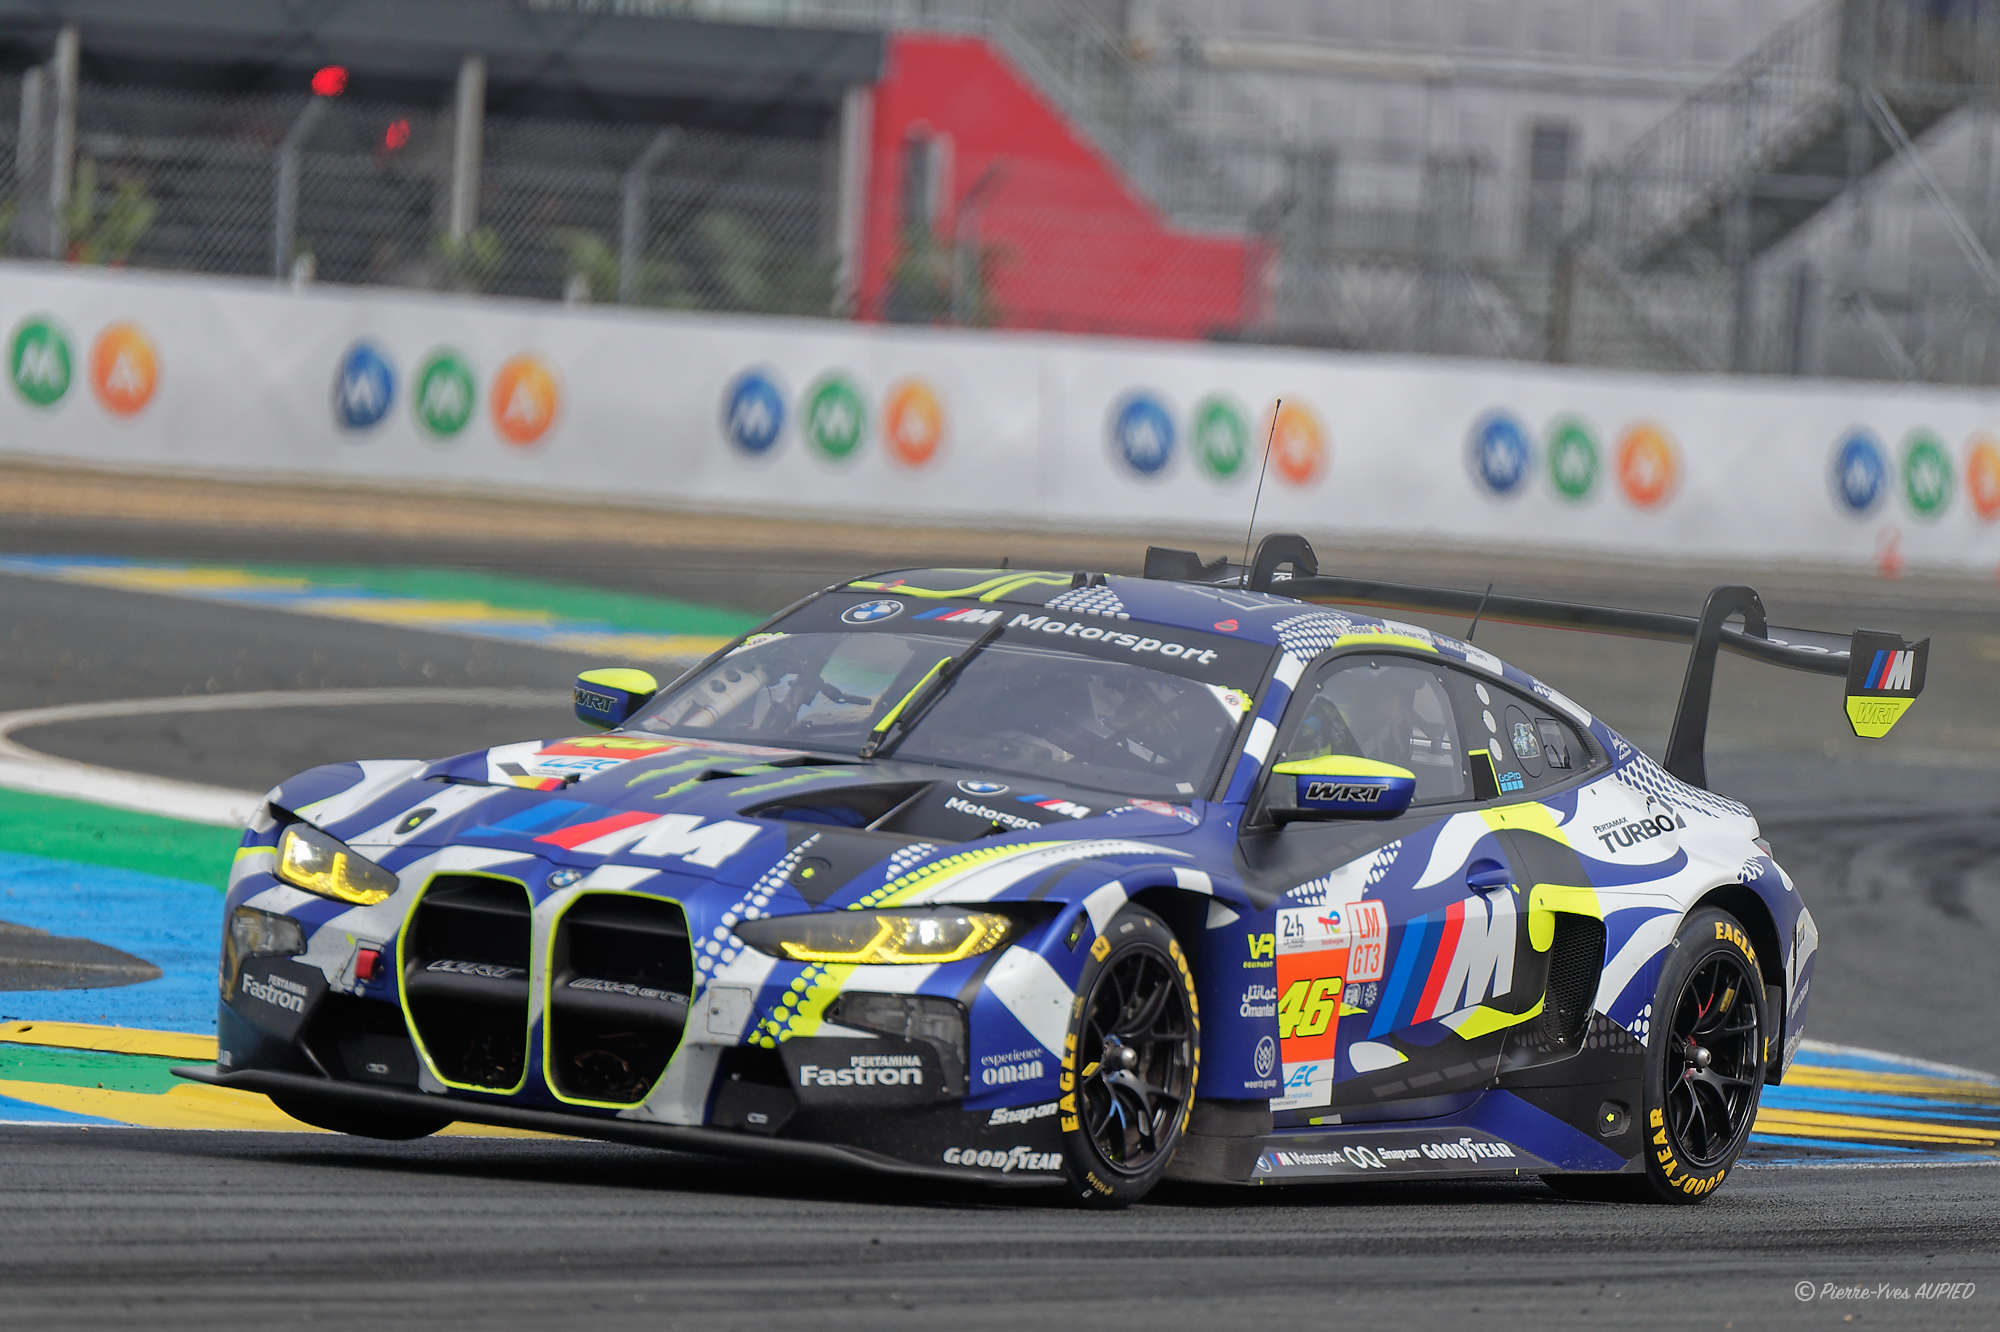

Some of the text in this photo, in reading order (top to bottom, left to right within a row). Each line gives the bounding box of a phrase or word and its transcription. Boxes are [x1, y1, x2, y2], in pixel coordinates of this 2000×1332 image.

[1007, 612, 1219, 666] Motorsport
[1855, 702, 1900, 725] WRT
[1305, 781, 1390, 803] WRT
[1498, 771, 1522, 782] GoPro
[568, 813, 763, 868] M
[1592, 816, 1629, 834] PERTAMAX
[1598, 814, 1675, 854] TURBO
[1355, 906, 1380, 939] LM
[1352, 942, 1381, 975] GT3
[1430, 886, 1518, 1019] M
[1714, 920, 1756, 966] EAGLE
[242, 972, 305, 1014] Fastron
[1277, 975, 1343, 1039] 46
[850, 1055, 922, 1067] PERTAMINA
[981, 1047, 1043, 1067] experience
[800, 1065, 922, 1087] Fastron
[982, 1060, 1044, 1086] oman
[1059, 1032, 1081, 1133] EAGLE
[988, 1102, 1059, 1126] Snap-on
[943, 1145, 1063, 1174] GOODYEAR
[1288, 1151, 1346, 1167] Motorsport
[1420, 1137, 1517, 1164] GOODYEAR
[1649, 1106, 1726, 1197] GOODYEAR
